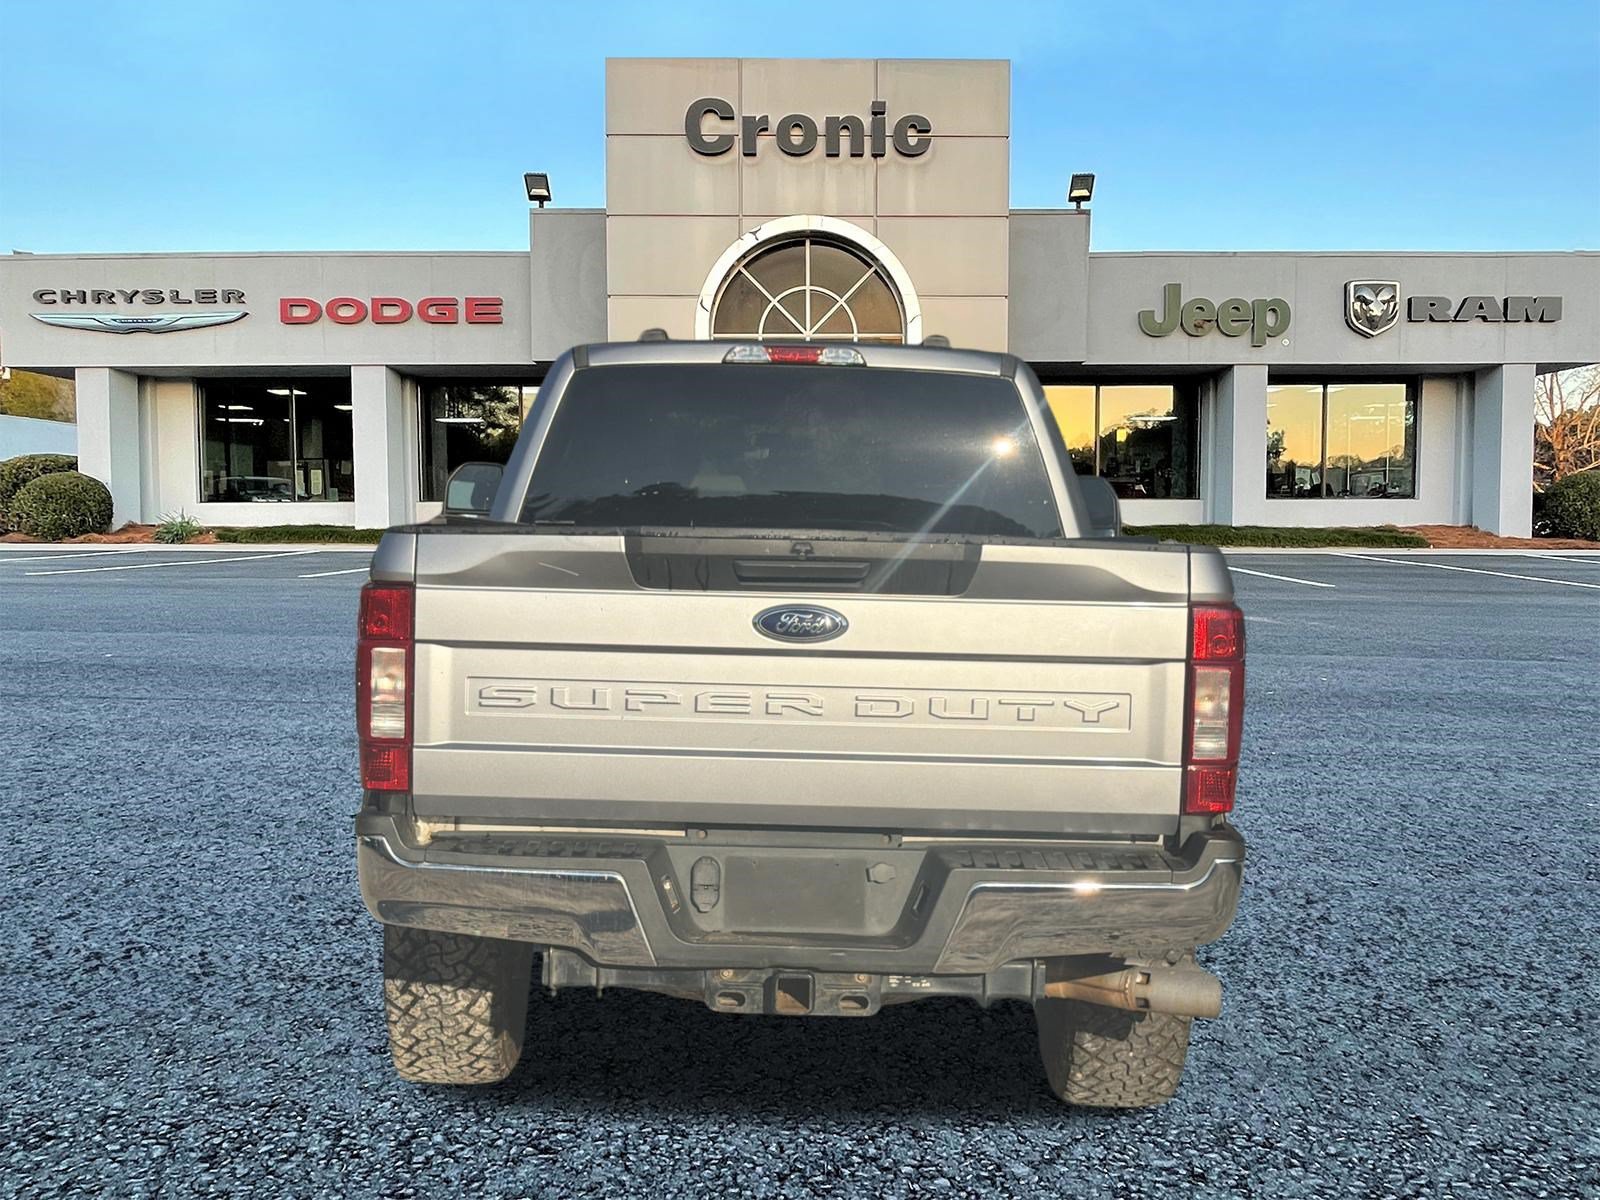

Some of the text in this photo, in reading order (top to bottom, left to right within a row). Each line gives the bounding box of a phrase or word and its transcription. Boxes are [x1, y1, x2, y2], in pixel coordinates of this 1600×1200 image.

[685, 97, 932, 157] Cronic
[32, 289, 246, 304] CHRYSLER
[1407, 296, 1563, 322] RAM
[280, 297, 503, 324] DODGE
[1138, 283, 1291, 347] Jeep
[776, 612, 826, 633] Ford
[478, 685, 1120, 723] SUPER DUTY
